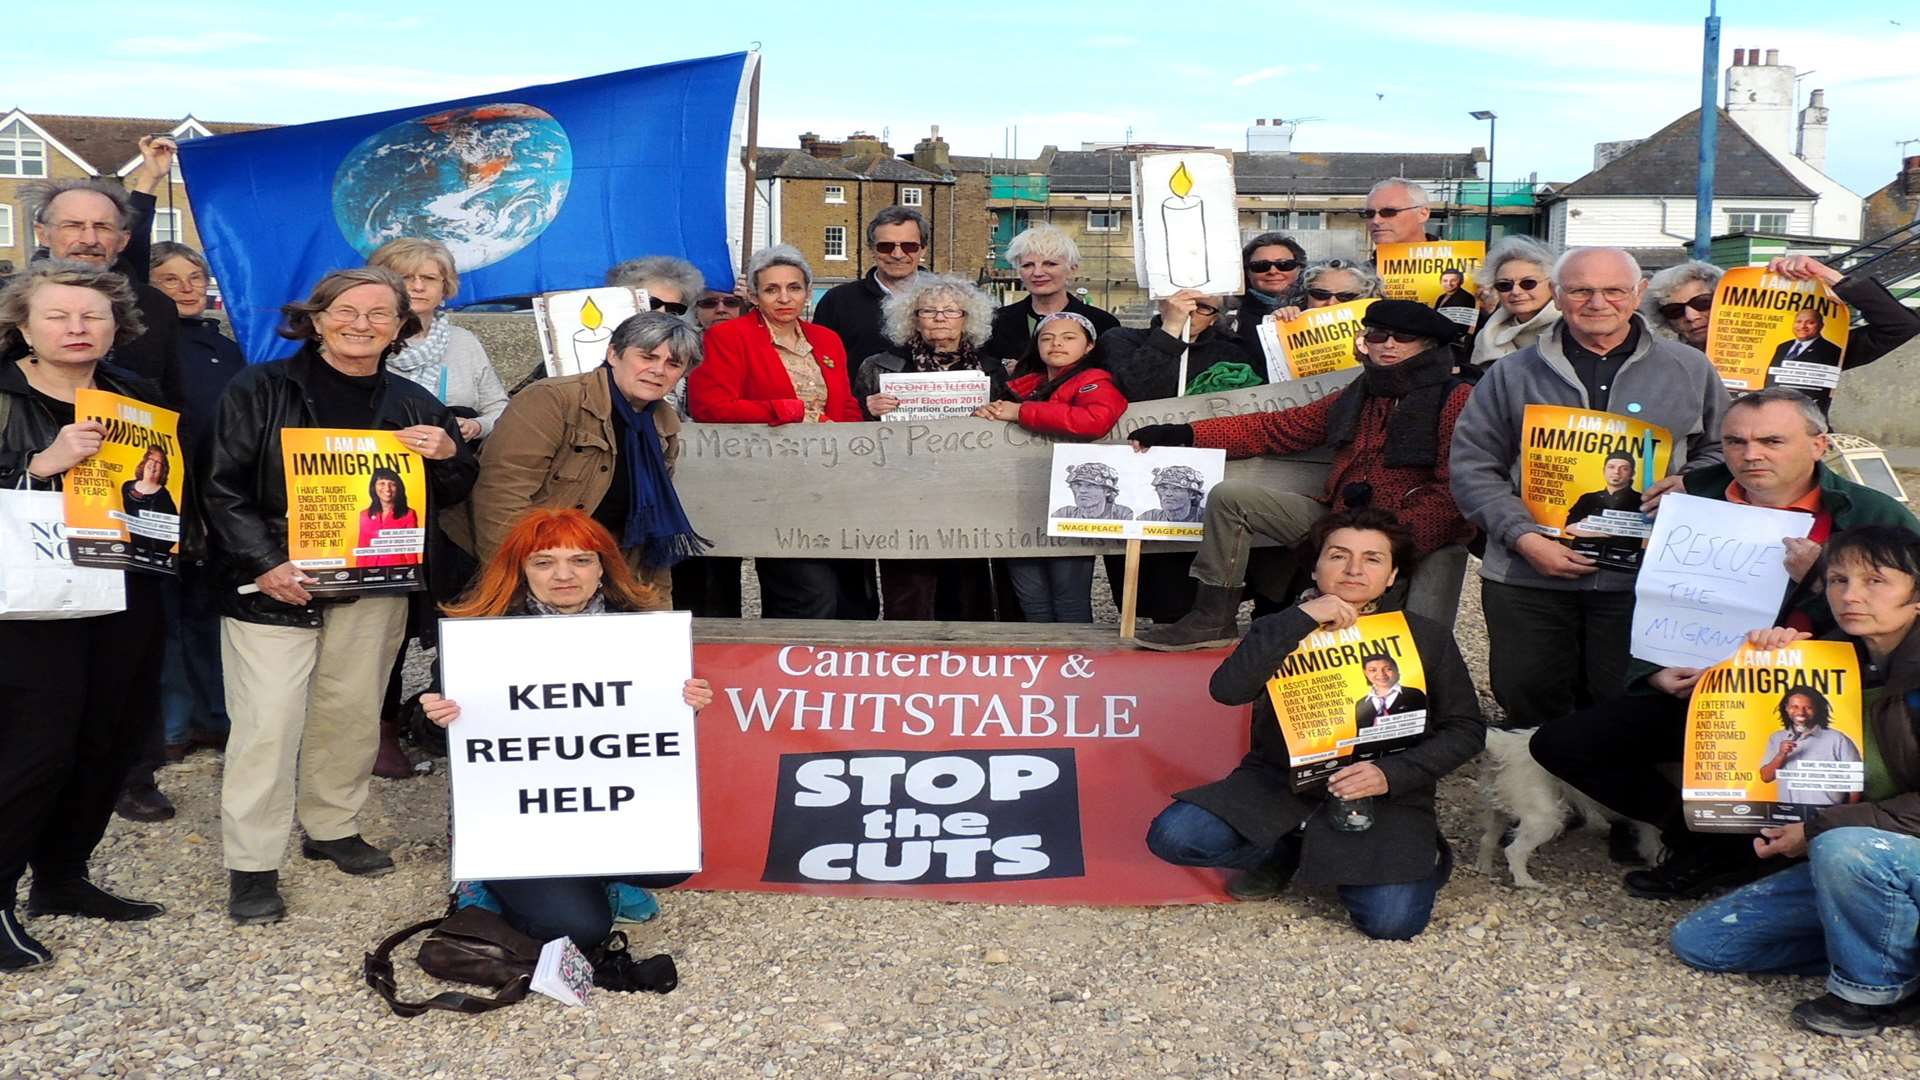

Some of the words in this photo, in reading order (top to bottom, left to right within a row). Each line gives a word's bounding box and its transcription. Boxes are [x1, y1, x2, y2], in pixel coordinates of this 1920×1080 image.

[1409, 248, 1413, 258] I
[1416, 247, 1433, 258] AM
[1437, 247, 1453, 258] AN
[1383, 258, 1478, 275] IMMIGRANT
[1769, 275, 1792, 290] AM
[1722, 286, 1838, 319] IMMIGRANT
[1308, 316, 1313, 327] I
[1316, 312, 1333, 326] AM
[1337, 308, 1352, 321] AN
[1287, 320, 1362, 350] IMMIGRA
[921, 396, 957, 405] Election
[960, 396, 983, 404] 2015
[895, 406, 940, 414] migration
[1568, 415, 1574, 429] I
[1578, 415, 1602, 432] AM
[1606, 420, 1627, 433] AN
[326, 437, 331, 451] I
[334, 436, 354, 451] AM
[357, 437, 376, 451] AN
[906, 424, 993, 457] Peace
[1529, 426, 1662, 459] IMMIGRANT
[293, 453, 412, 476] IMMIGRANT
[1530, 453, 1541, 461] FOR
[1545, 455, 1552, 463] 10
[1554, 456, 1578, 465] YEARS
[1530, 469, 1556, 479] FEEDING
[1557, 472, 1574, 481] OVER
[1551, 464, 1569, 472] BEEN
[74, 487, 80, 495] 9
[82, 487, 107, 496] YEARS
[301, 486, 319, 494] HAVE
[321, 486, 346, 494] TAUGHT
[298, 495, 327, 503] ENGLISH
[338, 494, 358, 502] OVER
[1529, 493, 1546, 502] EVERY
[1548, 497, 1567, 505] WEEK
[299, 504, 318, 512] 2400
[319, 503, 356, 511] STUDENTS
[300, 513, 315, 521] AND
[317, 512, 333, 520] WAS
[334, 512, 348, 520] THE
[300, 522, 320, 530] FIRST
[322, 521, 346, 529] BLACK
[300, 530, 341, 539] PRESIDENT
[841, 528, 899, 550] Lived
[909, 529, 929, 550] in
[300, 540, 309, 548] OF
[312, 539, 327, 547] THE
[329, 538, 344, 547] NUT
[1659, 525, 1781, 577] RESCUE
[1668, 582, 1716, 604] THE
[1311, 631, 1336, 649] AM
[1340, 626, 1361, 643] AN
[1733, 651, 1740, 666] I
[1744, 650, 1771, 666] AM
[1776, 649, 1803, 666] AN
[778, 645, 1048, 688] Canterbury
[1060, 654, 1095, 679] &
[1283, 680, 1309, 690] ASSIST
[1311, 673, 1342, 685] AROUND
[1700, 668, 1847, 695] IMMIGRANT
[509, 681, 632, 711] KENT
[1282, 690, 1300, 699] 1000
[1302, 681, 1348, 695] CUSTOMERS
[1284, 697, 1305, 706] DAILY
[1308, 694, 1323, 702] AND
[1325, 689, 1345, 698] HAVE
[1287, 704, 1306, 714] BEEN
[1308, 698, 1344, 710] WORKING
[1702, 700, 1745, 709] ENTERTAIN
[725, 687, 1140, 738] WHITSTABLE
[1289, 711, 1326, 722] NATIONAL
[1328, 707, 1345, 716] RAIL
[1696, 711, 1725, 719] PEOPLE
[1292, 719, 1328, 731] STATIONS
[1330, 717, 1344, 725] FOR
[1696, 721, 1711, 729] AND
[1713, 721, 1737, 729] HAVE
[1296, 731, 1305, 739] 15
[1306, 728, 1332, 738] YEARS
[1696, 731, 1746, 740] PERFORMED
[466, 732, 680, 763] REFUGEE
[1695, 741, 1717, 750] OVER
[1695, 751, 1715, 760] 1000
[1717, 751, 1738, 760] GIGS
[1695, 762, 1703, 770] IN
[1705, 762, 1722, 770] THE
[1724, 762, 1737, 770] UK
[795, 755, 1060, 807] STOP
[1695, 772, 1713, 780] AND
[1715, 772, 1753, 781] IRELAND
[519, 786, 635, 814] HELP
[862, 808, 990, 839] the
[799, 834, 1050, 881] CUTS
